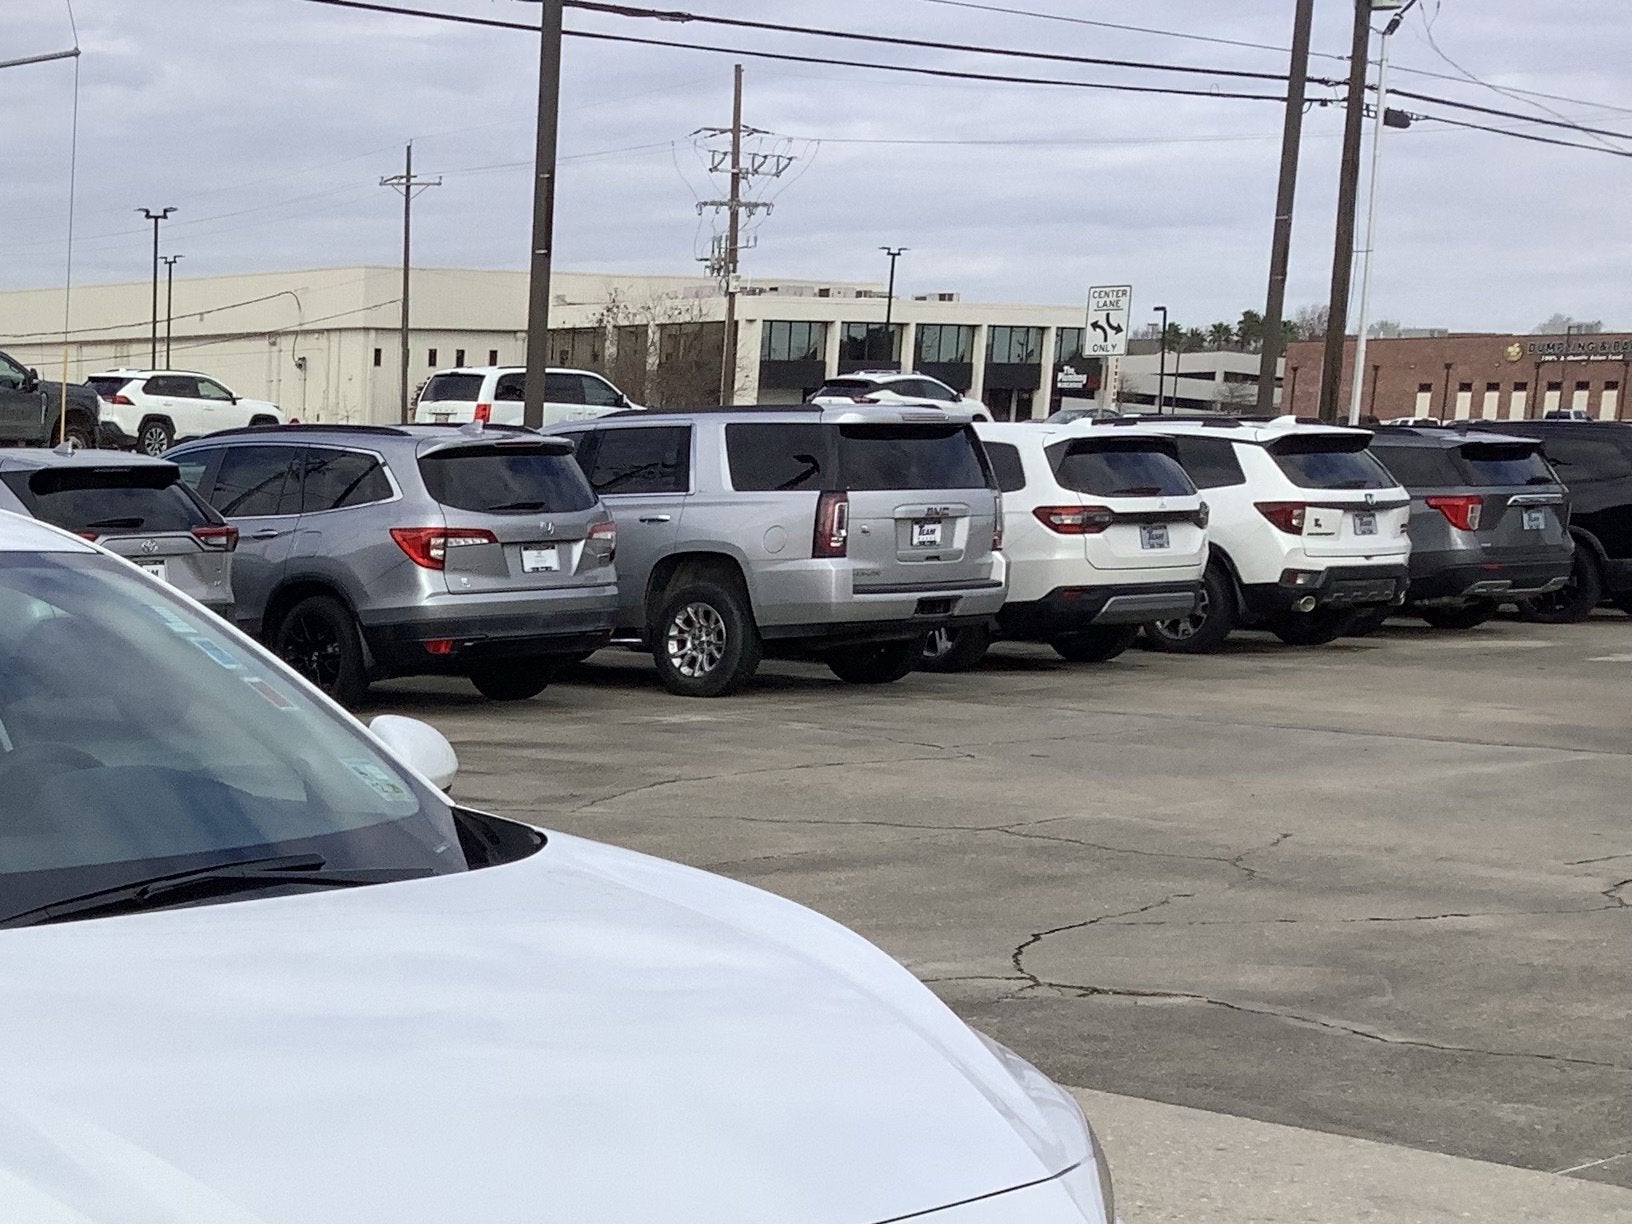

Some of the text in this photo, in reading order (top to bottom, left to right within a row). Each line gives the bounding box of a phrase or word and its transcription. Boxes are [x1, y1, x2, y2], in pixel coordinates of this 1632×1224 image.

[1092, 289, 1128, 299] CENTER
[1096, 299, 1122, 309] LANE
[1092, 343, 1118, 353] ONLY
